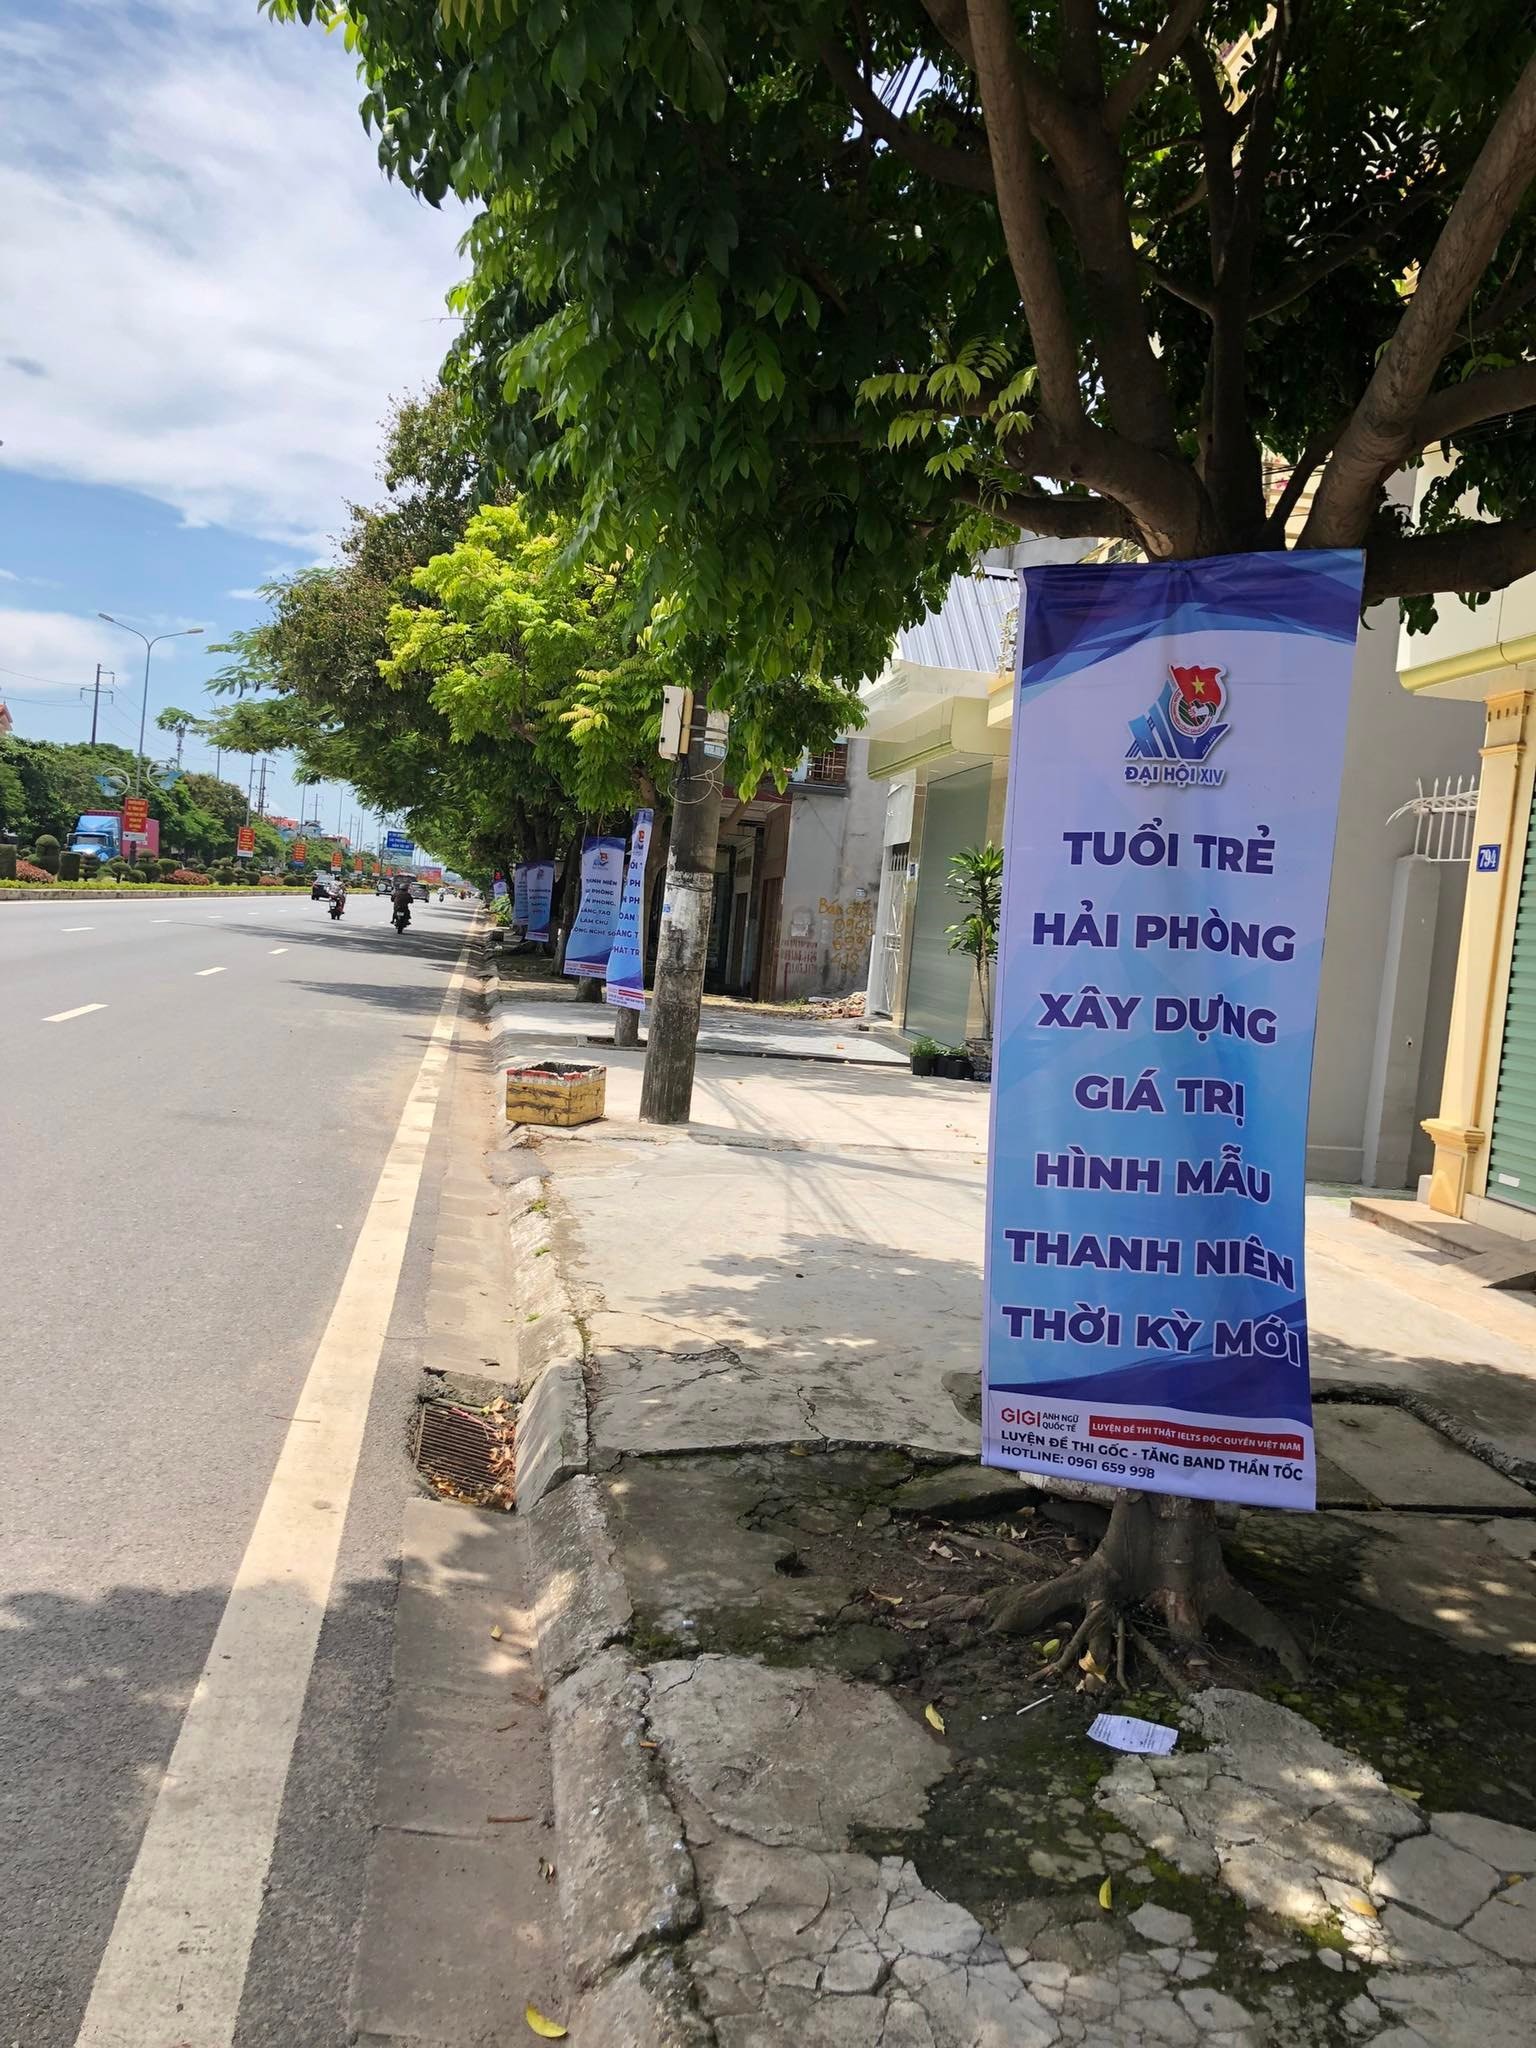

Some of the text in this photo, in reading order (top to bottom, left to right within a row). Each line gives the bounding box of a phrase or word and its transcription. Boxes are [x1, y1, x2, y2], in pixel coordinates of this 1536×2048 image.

[1125, 764, 1224, 786] ĐẠI HỘI XIV
[1063, 818, 1275, 875] TUỔI TRẺ
[1480, 848, 1497, 869] 794
[1033, 900, 1296, 961] HẢI PHÒNG
[1038, 985, 1277, 1045] XÂY DỰNG
[1074, 1068, 1245, 1128] GIÁ TRỊ
[1036, 1144, 1272, 1203] HÌNH MẪU
[1005, 1229, 1296, 1292] THANH NIÊN
[1002, 1303, 1301, 1367] THỜI KỲ MỚI
[1001, 1407, 1041, 1427] GIGI
[1042, 1412, 1079, 1424] ANH NGỮ
[1042, 1421, 1076, 1433] QUỐC TẾ
[1092, 1422, 1121, 1434] LUYỆN
[1137, 1426, 1152, 1435] THI
[1153, 1427, 1176, 1440] THẬT
[1177, 1431, 1201, 1442] IELTS
[1202, 1434, 1222, 1445] ĐỘC
[1223, 1436, 1256, 1447] QUYỀN
[1257, 1440, 1278, 1450] VIỆT
[1279, 1442, 1301, 1452] NAM
[1001, 1430, 1045, 1447] LUYỆN
[1049, 1435, 1068, 1449] ĐỀ
[1072, 1440, 1094, 1453] THI
[1098, 1442, 1128, 1458] GỐC
[1141, 1446, 1179, 1466] TĂNG
[1183, 1456, 1225, 1470] BAND
[1229, 1457, 1269, 1477] THẦN
[1273, 1462, 1303, 1481] TỐC
[1001, 1446, 1155, 1479] HOTLINE: 0961 659 998
